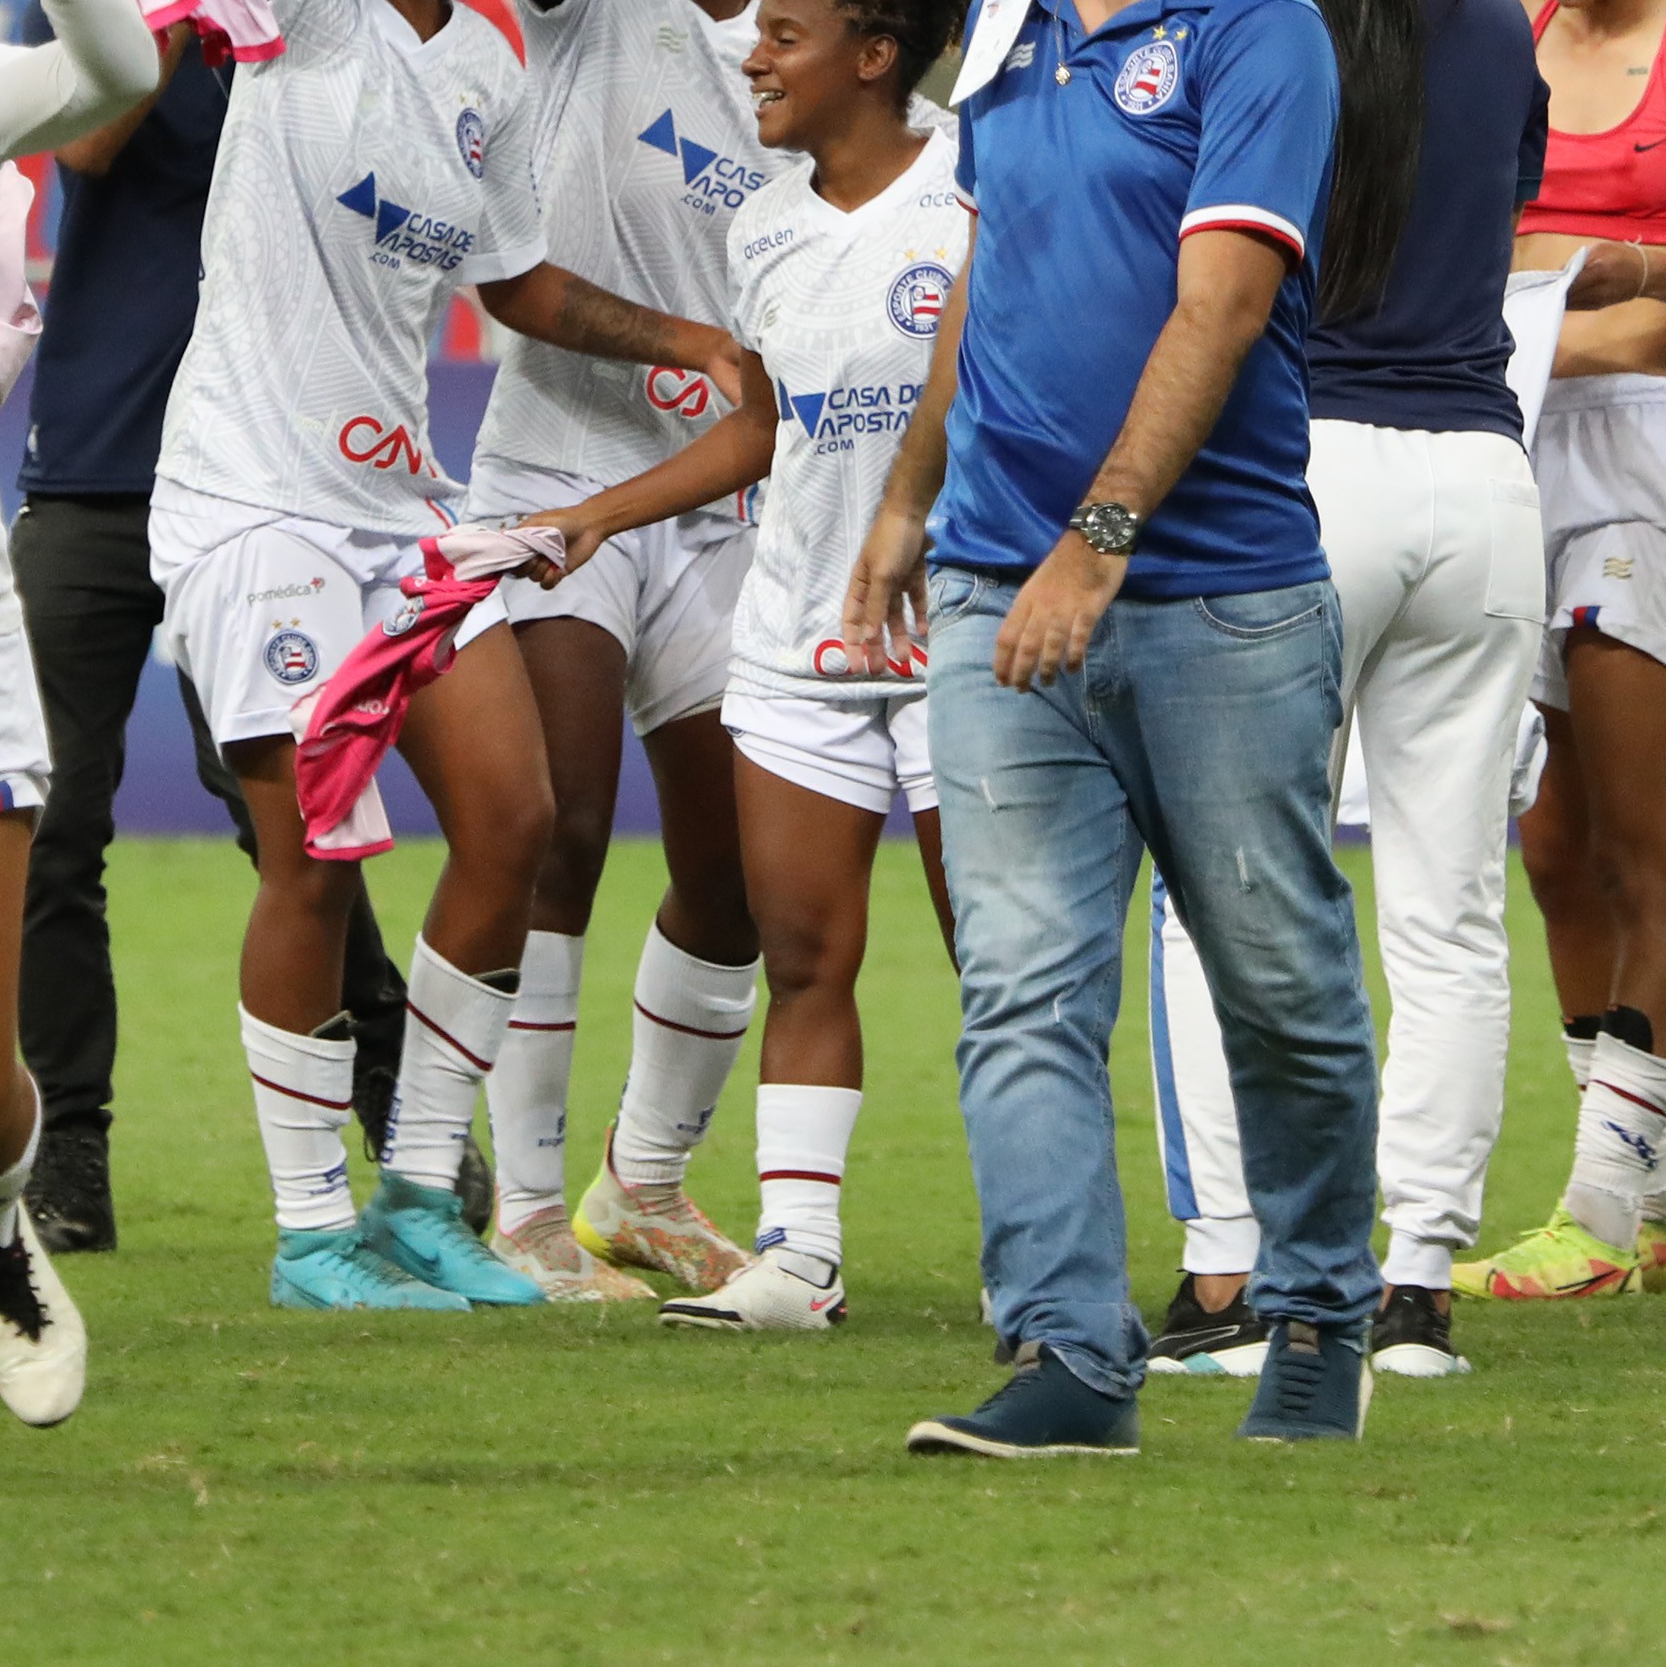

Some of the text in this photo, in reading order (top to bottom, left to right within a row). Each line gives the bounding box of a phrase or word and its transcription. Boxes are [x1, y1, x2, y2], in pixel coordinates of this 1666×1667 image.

[714, 157, 772, 191] CAS
[406, 213, 476, 253] CASA DE
[744, 228, 794, 260] acelen
[380, 233, 463, 272] APOSAS
[828, 383, 890, 410] CASA
[813, 439, 854, 455] .COM
